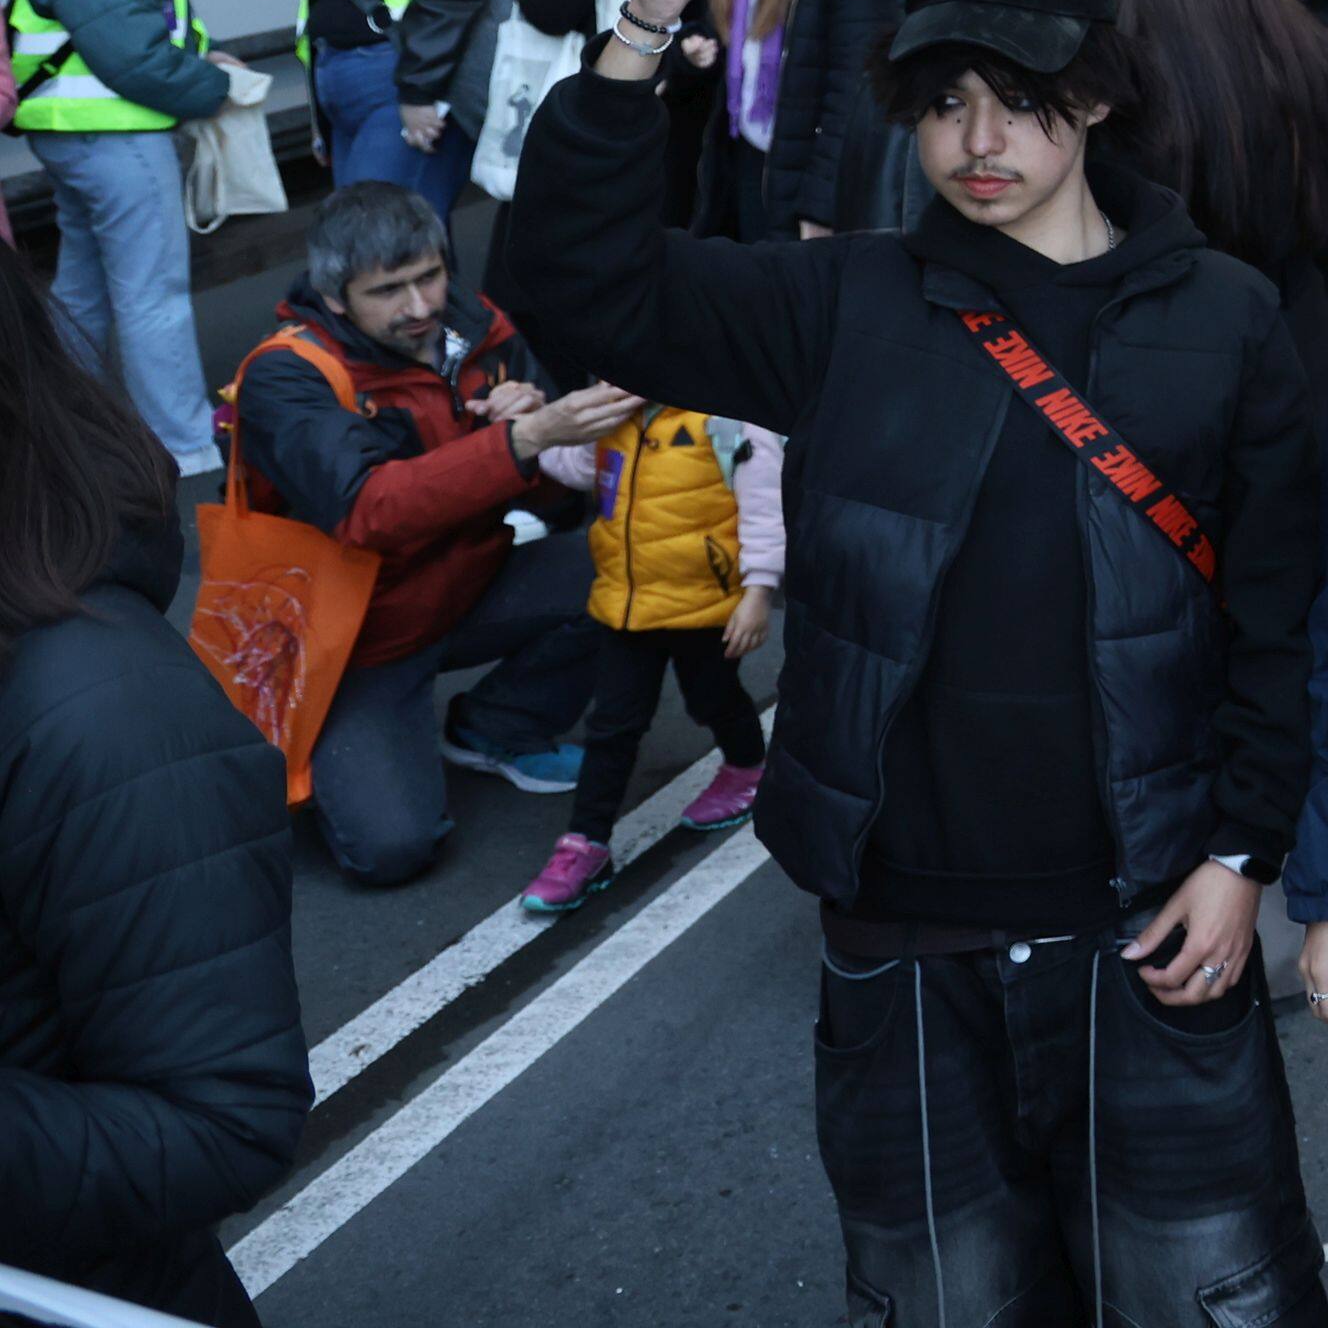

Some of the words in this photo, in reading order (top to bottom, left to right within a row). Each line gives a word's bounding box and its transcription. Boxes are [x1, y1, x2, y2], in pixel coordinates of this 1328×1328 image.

[982, 329, 1055, 390] NIKE
[1034, 387, 1110, 449] NIKE
[1090, 444, 1163, 504] NIKE
[1145, 494, 1199, 547] NIKE
